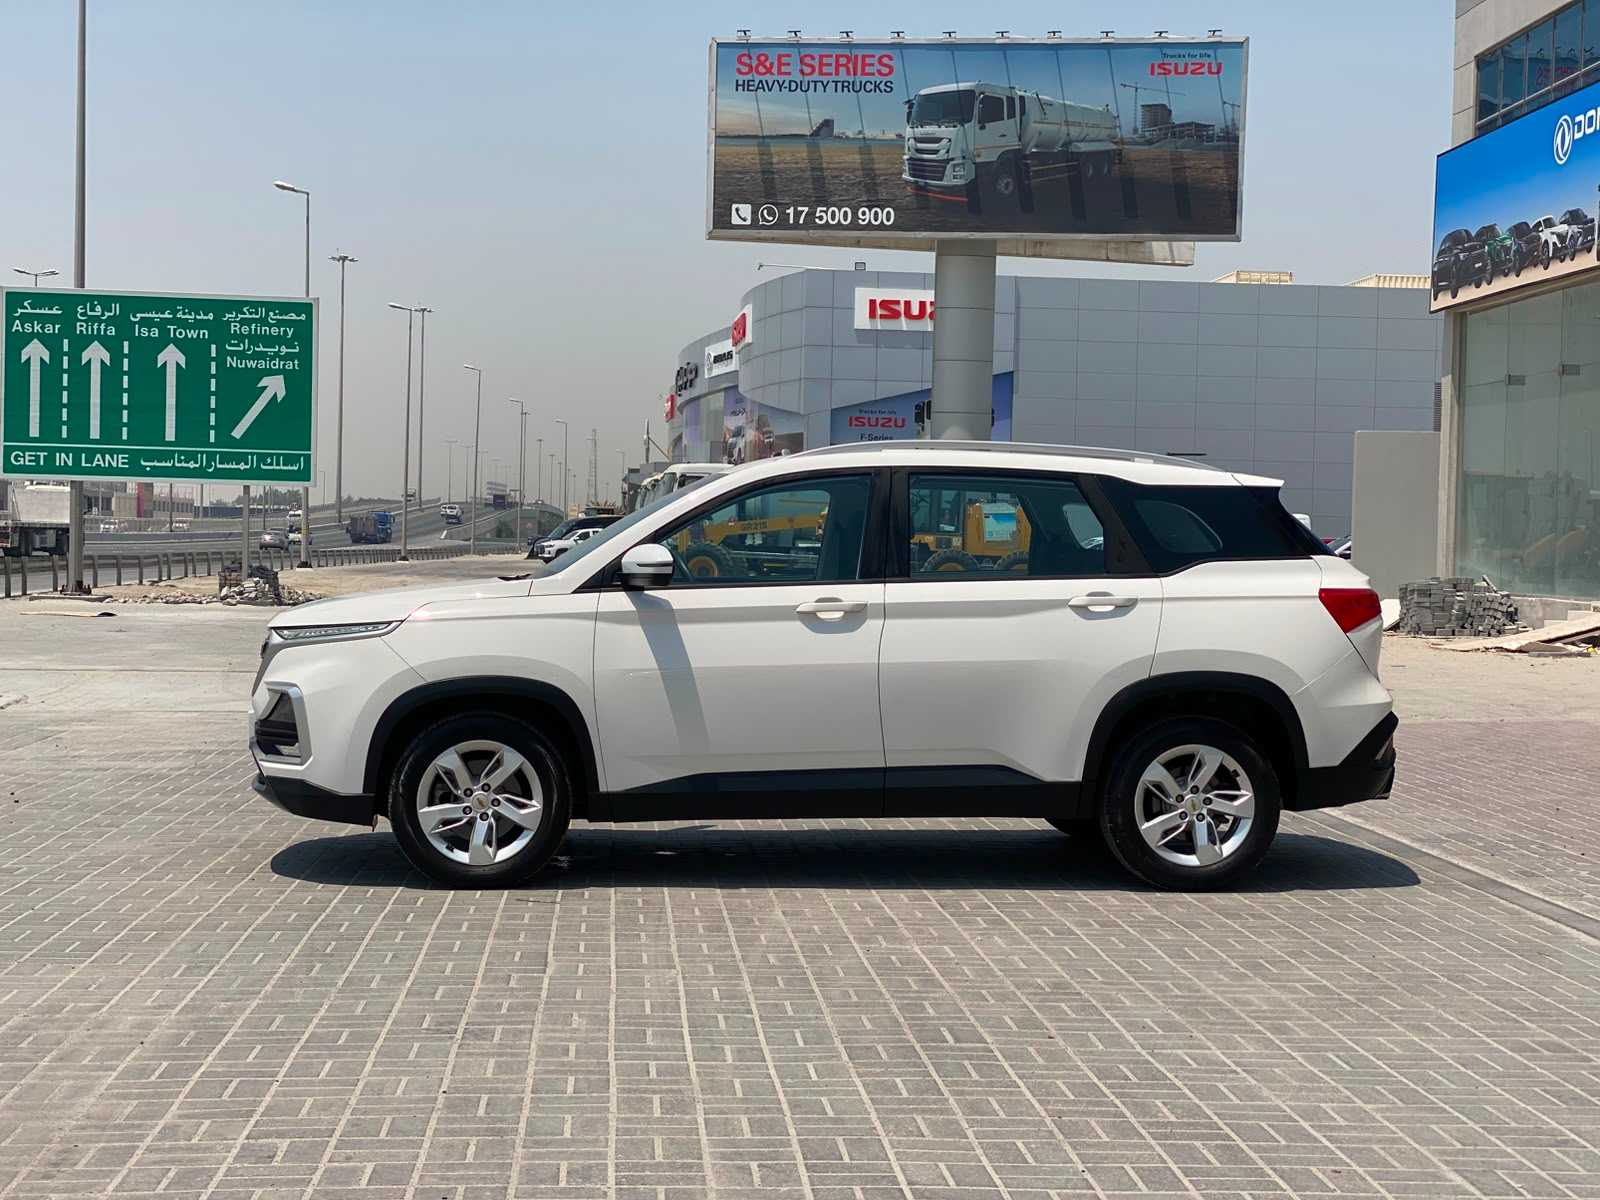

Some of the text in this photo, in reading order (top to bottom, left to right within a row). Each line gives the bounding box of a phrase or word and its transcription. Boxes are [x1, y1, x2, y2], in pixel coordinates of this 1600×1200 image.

[735, 53, 895, 77] S&E SERIES
[1150, 62, 1223, 76] ISUZU
[735, 79, 894, 94] HEAVY-DUTY TRUCKS
[785, 206, 895, 225] 17 500 900
[13, 299, 63, 317] عسكر
[76, 300, 120, 320] الرفاع
[129, 305, 214, 323] مدينة عيسى
[221, 306, 306, 324] مصنع التكرير
[868, 298, 936, 321] ISU
[12, 319, 61, 334] Askar
[76, 321, 116, 336] Riffa
[134, 324, 209, 339] Isa Town
[230, 322, 295, 338] Refinery
[225, 338, 300, 355] نويدرات
[226, 355, 300, 370] Nuwaidrat
[848, 416, 906, 428] ISUZU
[10, 451, 129, 468] GET IN LANE
[140, 451, 305, 473] اسلك المسار المناسب
